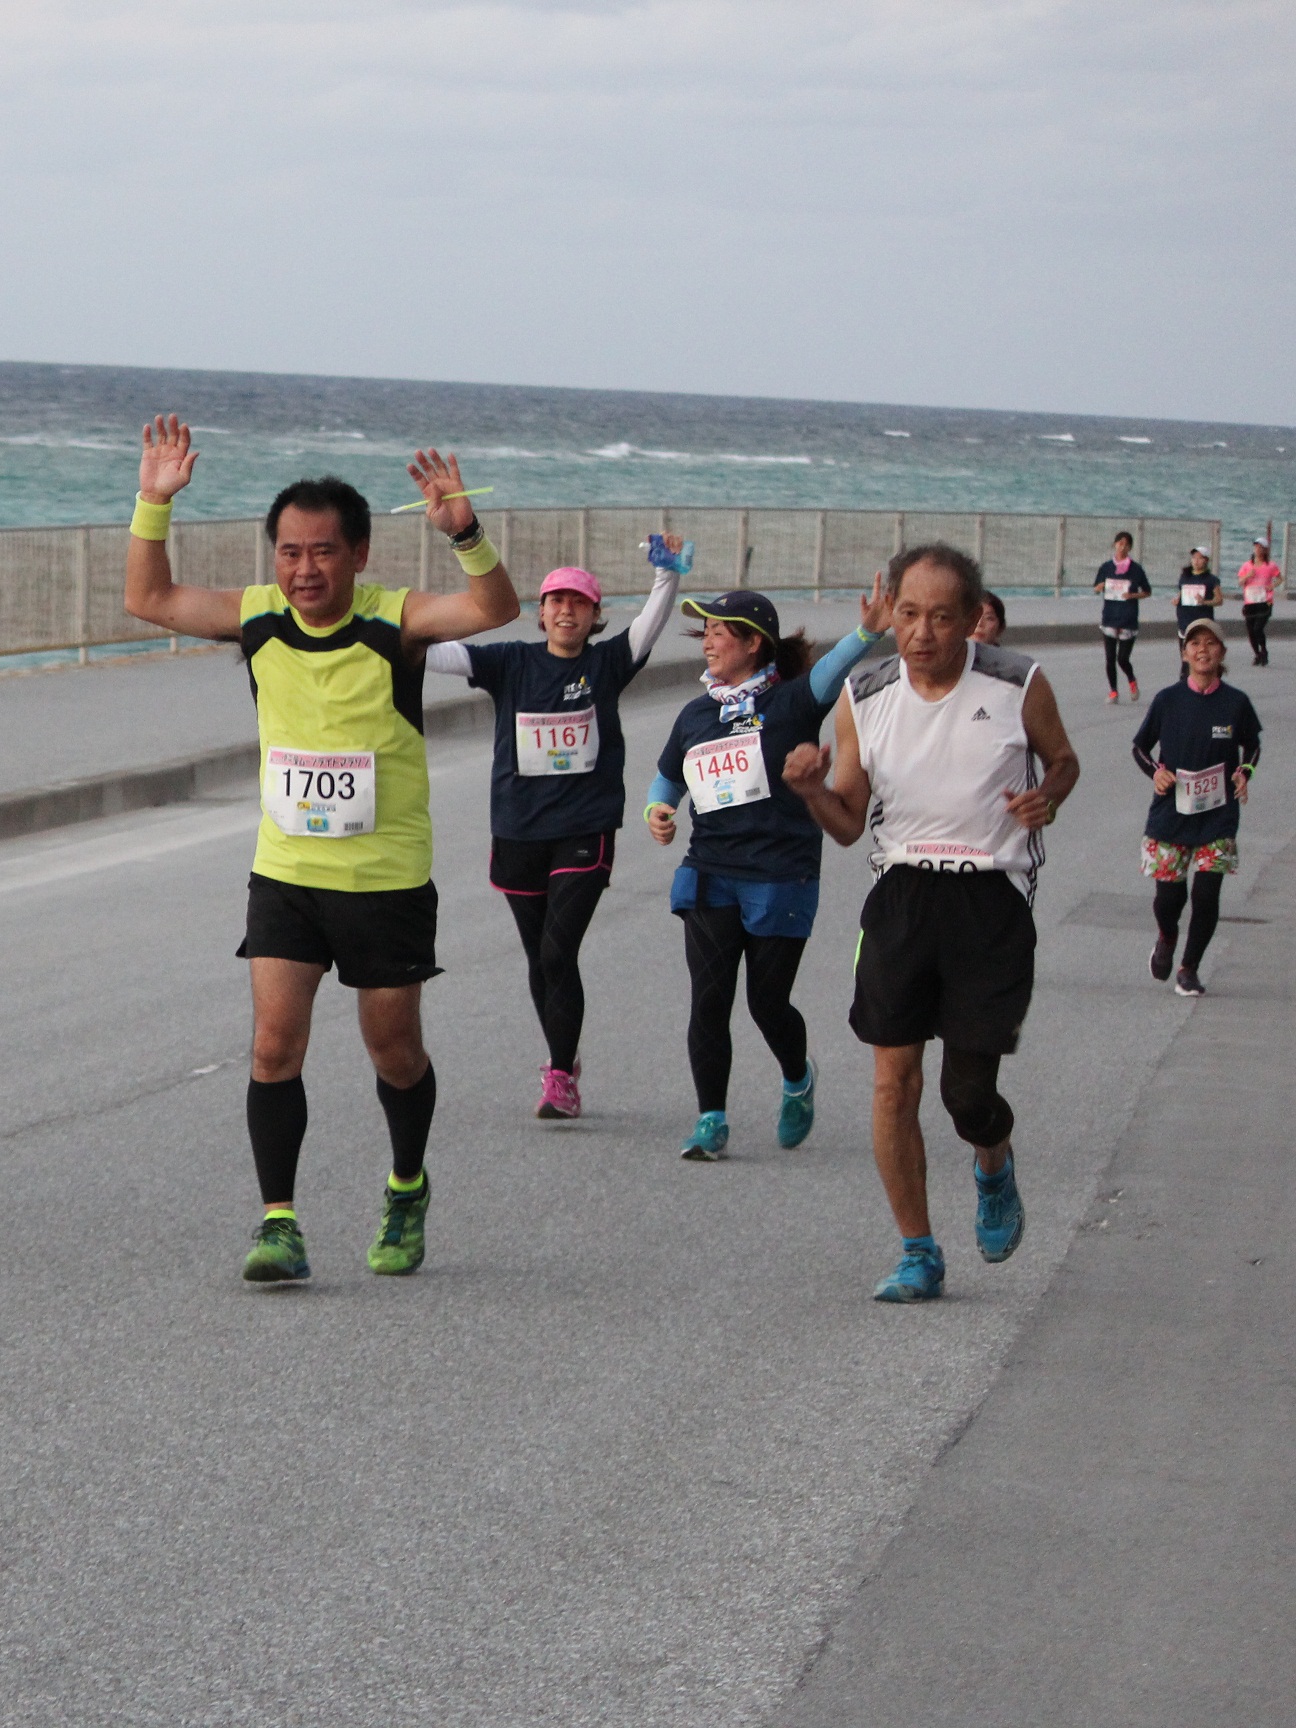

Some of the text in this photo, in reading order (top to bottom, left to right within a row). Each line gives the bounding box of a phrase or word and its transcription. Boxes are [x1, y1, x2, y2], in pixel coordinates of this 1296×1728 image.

[533, 724, 590, 748] 1167
[695, 749, 749, 781] 1446
[283, 768, 355, 800] 1703
[1185, 775, 1219, 796] 1529
